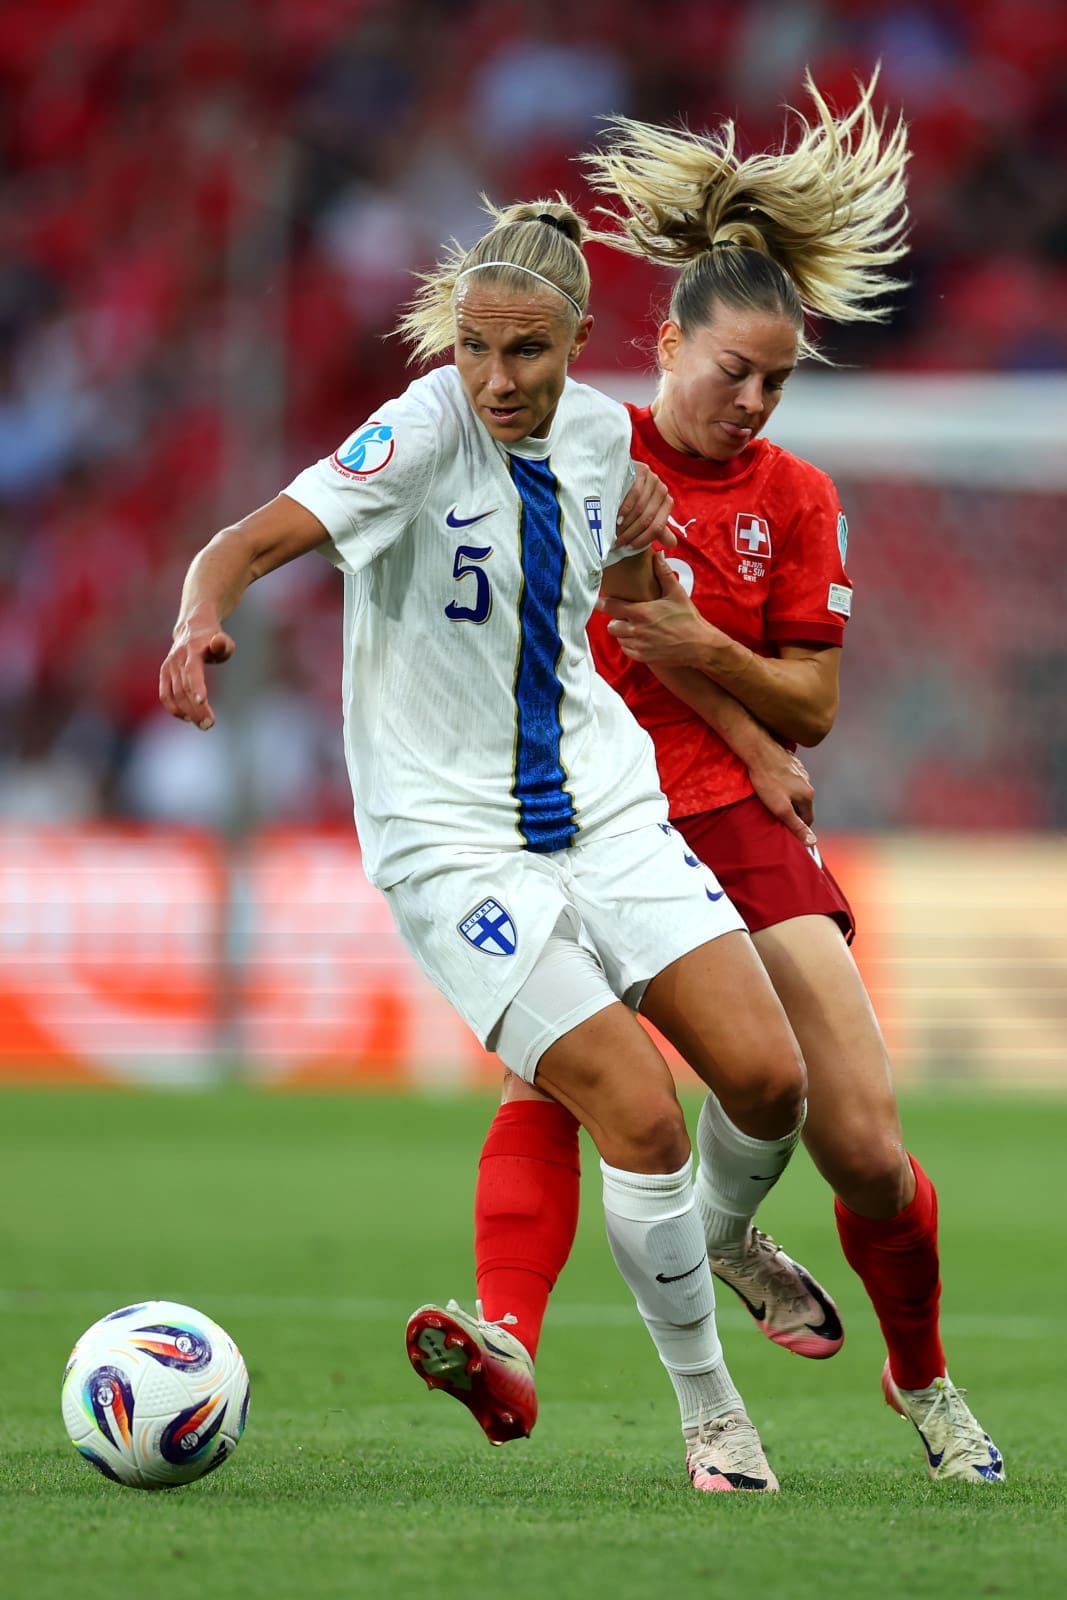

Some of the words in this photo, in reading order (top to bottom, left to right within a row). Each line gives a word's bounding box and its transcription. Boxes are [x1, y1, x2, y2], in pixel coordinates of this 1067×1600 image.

[445, 545, 493, 624] 5
[753, 567, 765, 577] SUI
[464, 903, 491, 929] SUOMI
